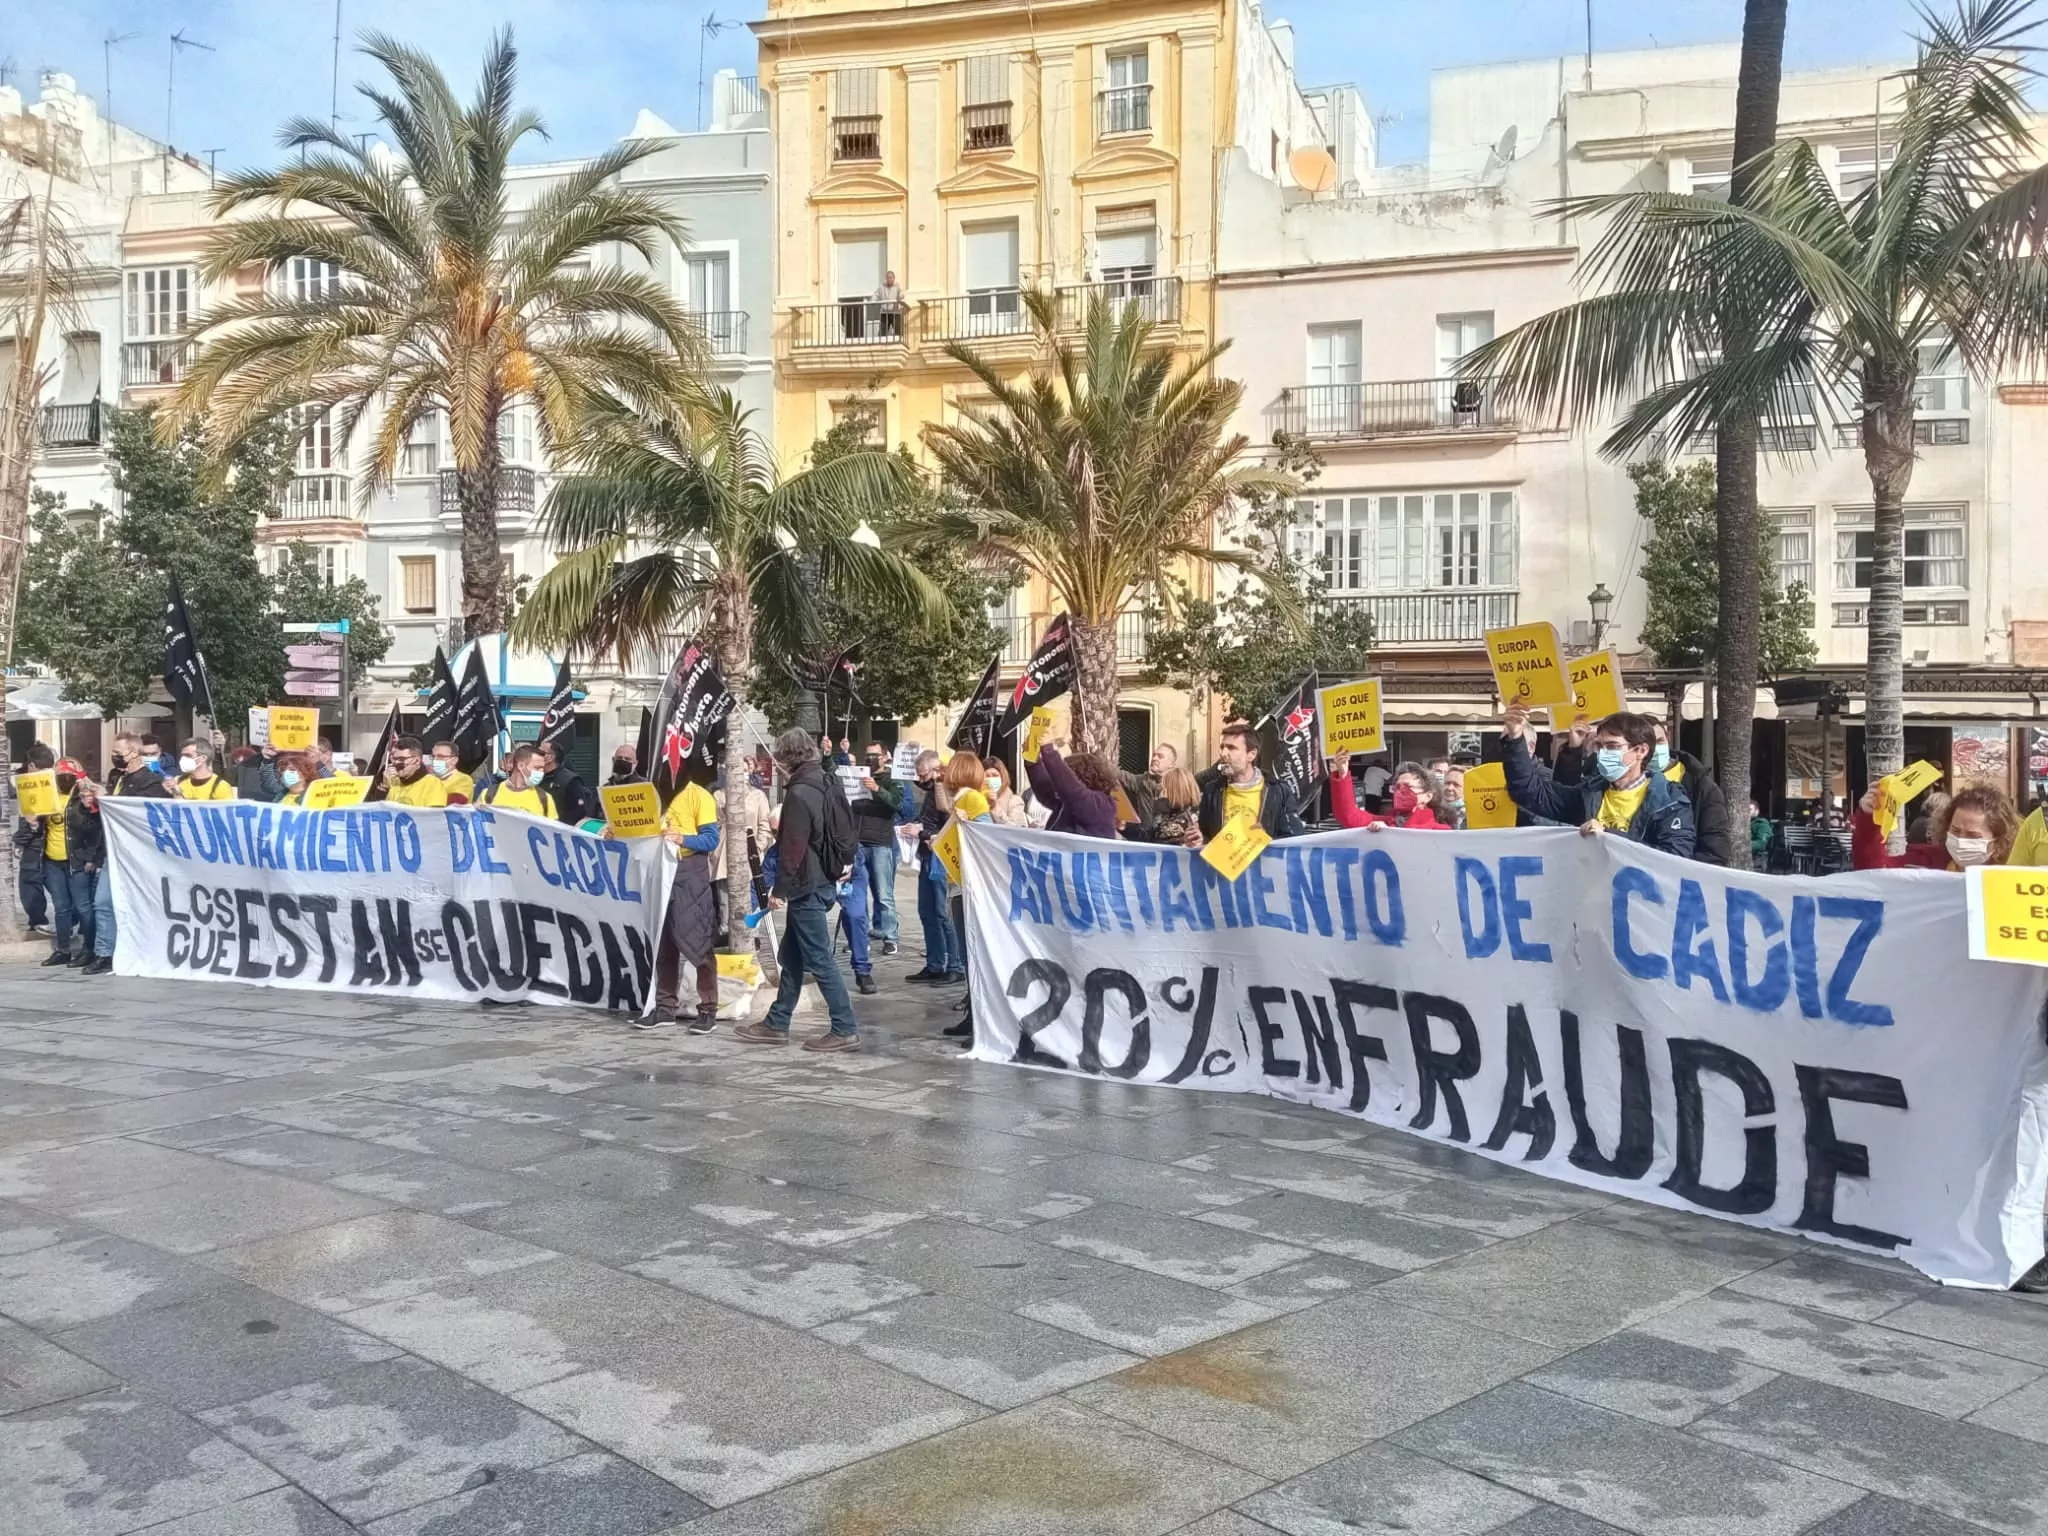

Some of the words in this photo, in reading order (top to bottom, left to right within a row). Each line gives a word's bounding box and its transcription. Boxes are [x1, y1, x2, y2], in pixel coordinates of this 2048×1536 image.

[1497, 639, 1538, 654] EUROPA
[1498, 660, 1515, 673] NOS
[1516, 657, 1553, 671] AVALA
[1591, 663, 1609, 678] YA
[1332, 696, 1347, 708] LOS
[1349, 693, 1370, 705] QUE
[1336, 711, 1367, 724] ESTAN
[1337, 727, 1376, 740] QUEDAN
[611, 794, 627, 804] LOS
[627, 792, 645, 802] QUE
[618, 806, 644, 815] ESTAN
[614, 819, 625, 828] SE
[625, 817, 655, 828] QUEDAN
[144, 801, 422, 873] AYUNTAMIENTO
[445, 810, 511, 875] DE
[527, 825, 642, 904] CADIZ
[943, 841, 953, 856] SE
[2015, 883, 2048, 896] LO
[161, 876, 235, 929] LOS
[235, 888, 424, 987] ESTAN
[414, 928, 451, 962] SE
[1999, 926, 2028, 940] SE
[1454, 855, 1553, 963] DE
[1611, 865, 1895, 1028] CADIZ
[167, 924, 236, 976] QUE
[1006, 958, 1236, 1084] 20%
[1248, 986, 1343, 1090] EN
[1330, 977, 1912, 1249] FRAUDE
